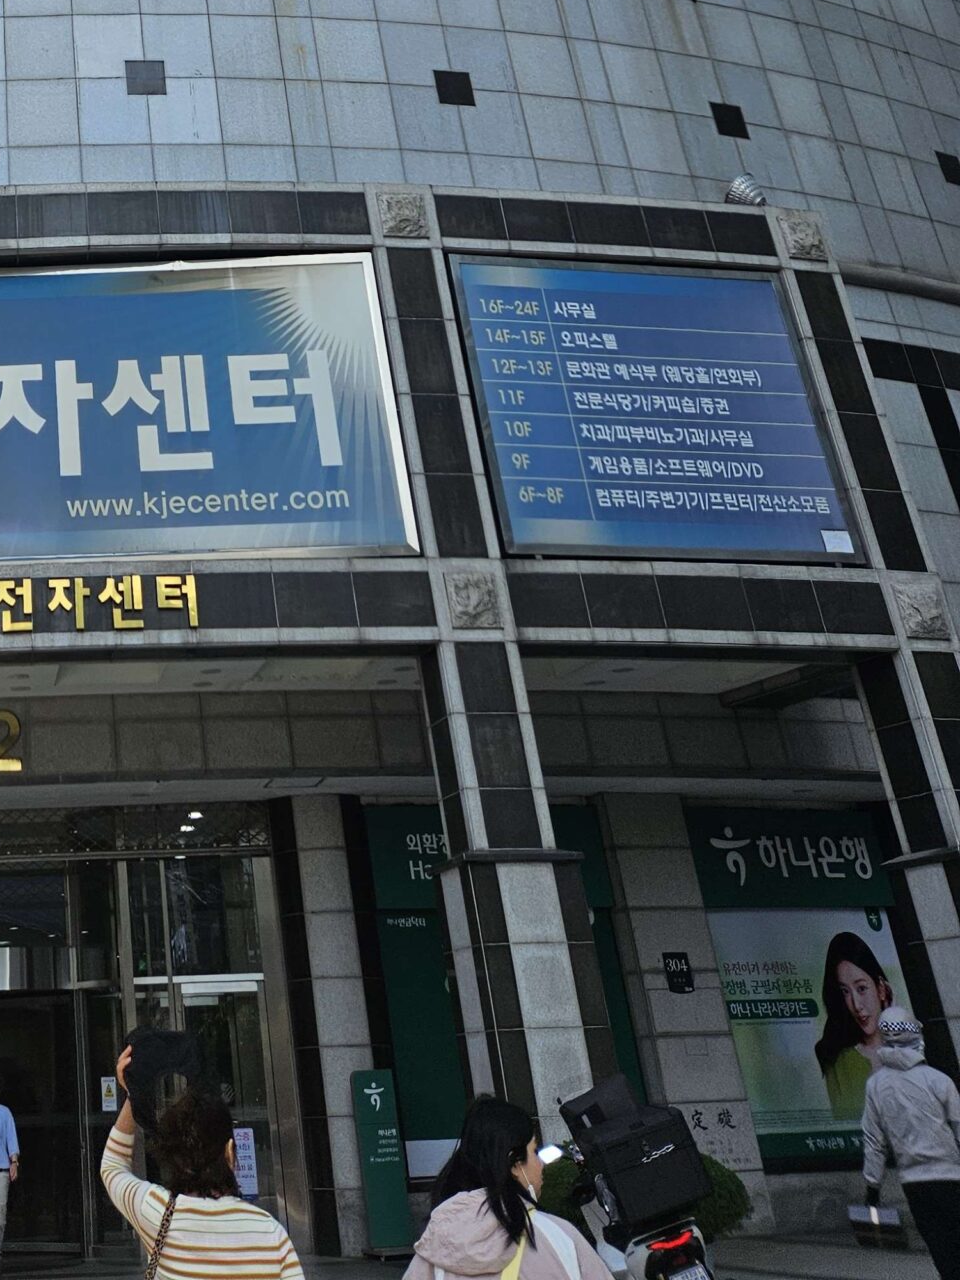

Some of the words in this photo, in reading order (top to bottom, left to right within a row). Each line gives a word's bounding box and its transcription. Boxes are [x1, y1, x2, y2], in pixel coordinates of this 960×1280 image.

[480, 298, 540, 316] 16F~24F
[554, 301, 597, 320] 사무실
[486, 328, 546, 345] 14F~15F
[560, 331, 619, 350] 오피스텔
[492, 359, 553, 376] 12F~13F
[566, 361, 612, 380] 문화관
[614, 364, 658, 382] 예식부
[498, 389, 526, 406] 11F
[504, 421, 533, 437] 10F
[511, 453, 531, 470] 9F
[66, 487, 351, 519] www.kjecenter.com
[519, 486, 565, 504] 6F~8F
[755, 835, 874, 880] 하나은행
[665, 958, 689, 972] 304
[720, 979, 751, 996] 장병,
[782, 979, 814, 995] 필수품
[730, 1001, 752, 1017] 하나
[752, 1001, 810, 1017] 나라사랑카드
